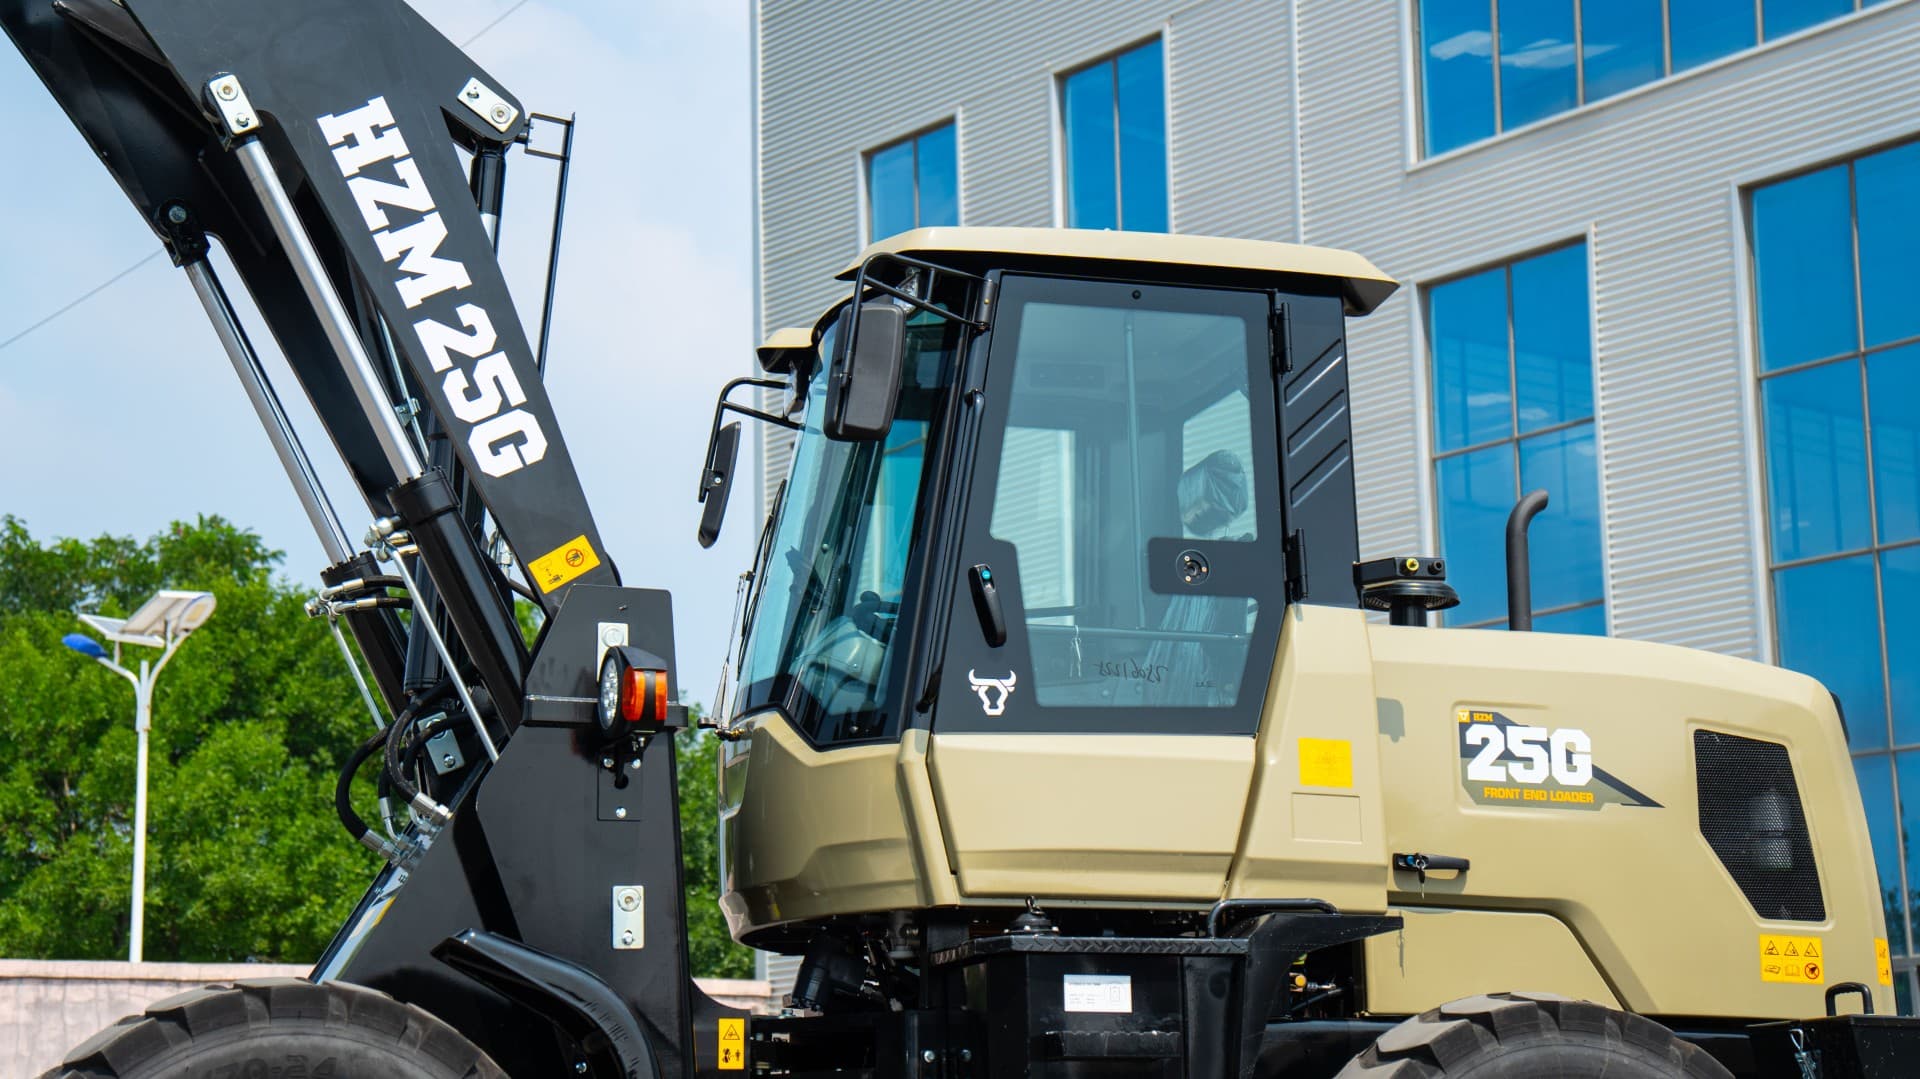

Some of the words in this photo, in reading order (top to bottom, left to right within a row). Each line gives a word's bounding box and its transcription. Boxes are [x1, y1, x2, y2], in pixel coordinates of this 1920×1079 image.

[317, 96, 473, 310] HZM
[413, 303, 549, 478] 25G
[1473, 712, 1494, 722] HZM
[1465, 723, 1594, 786] 25G
[1484, 786, 1521, 800] FRONT
[1523, 788, 1547, 801] END
[1550, 790, 1594, 803] LOADER
